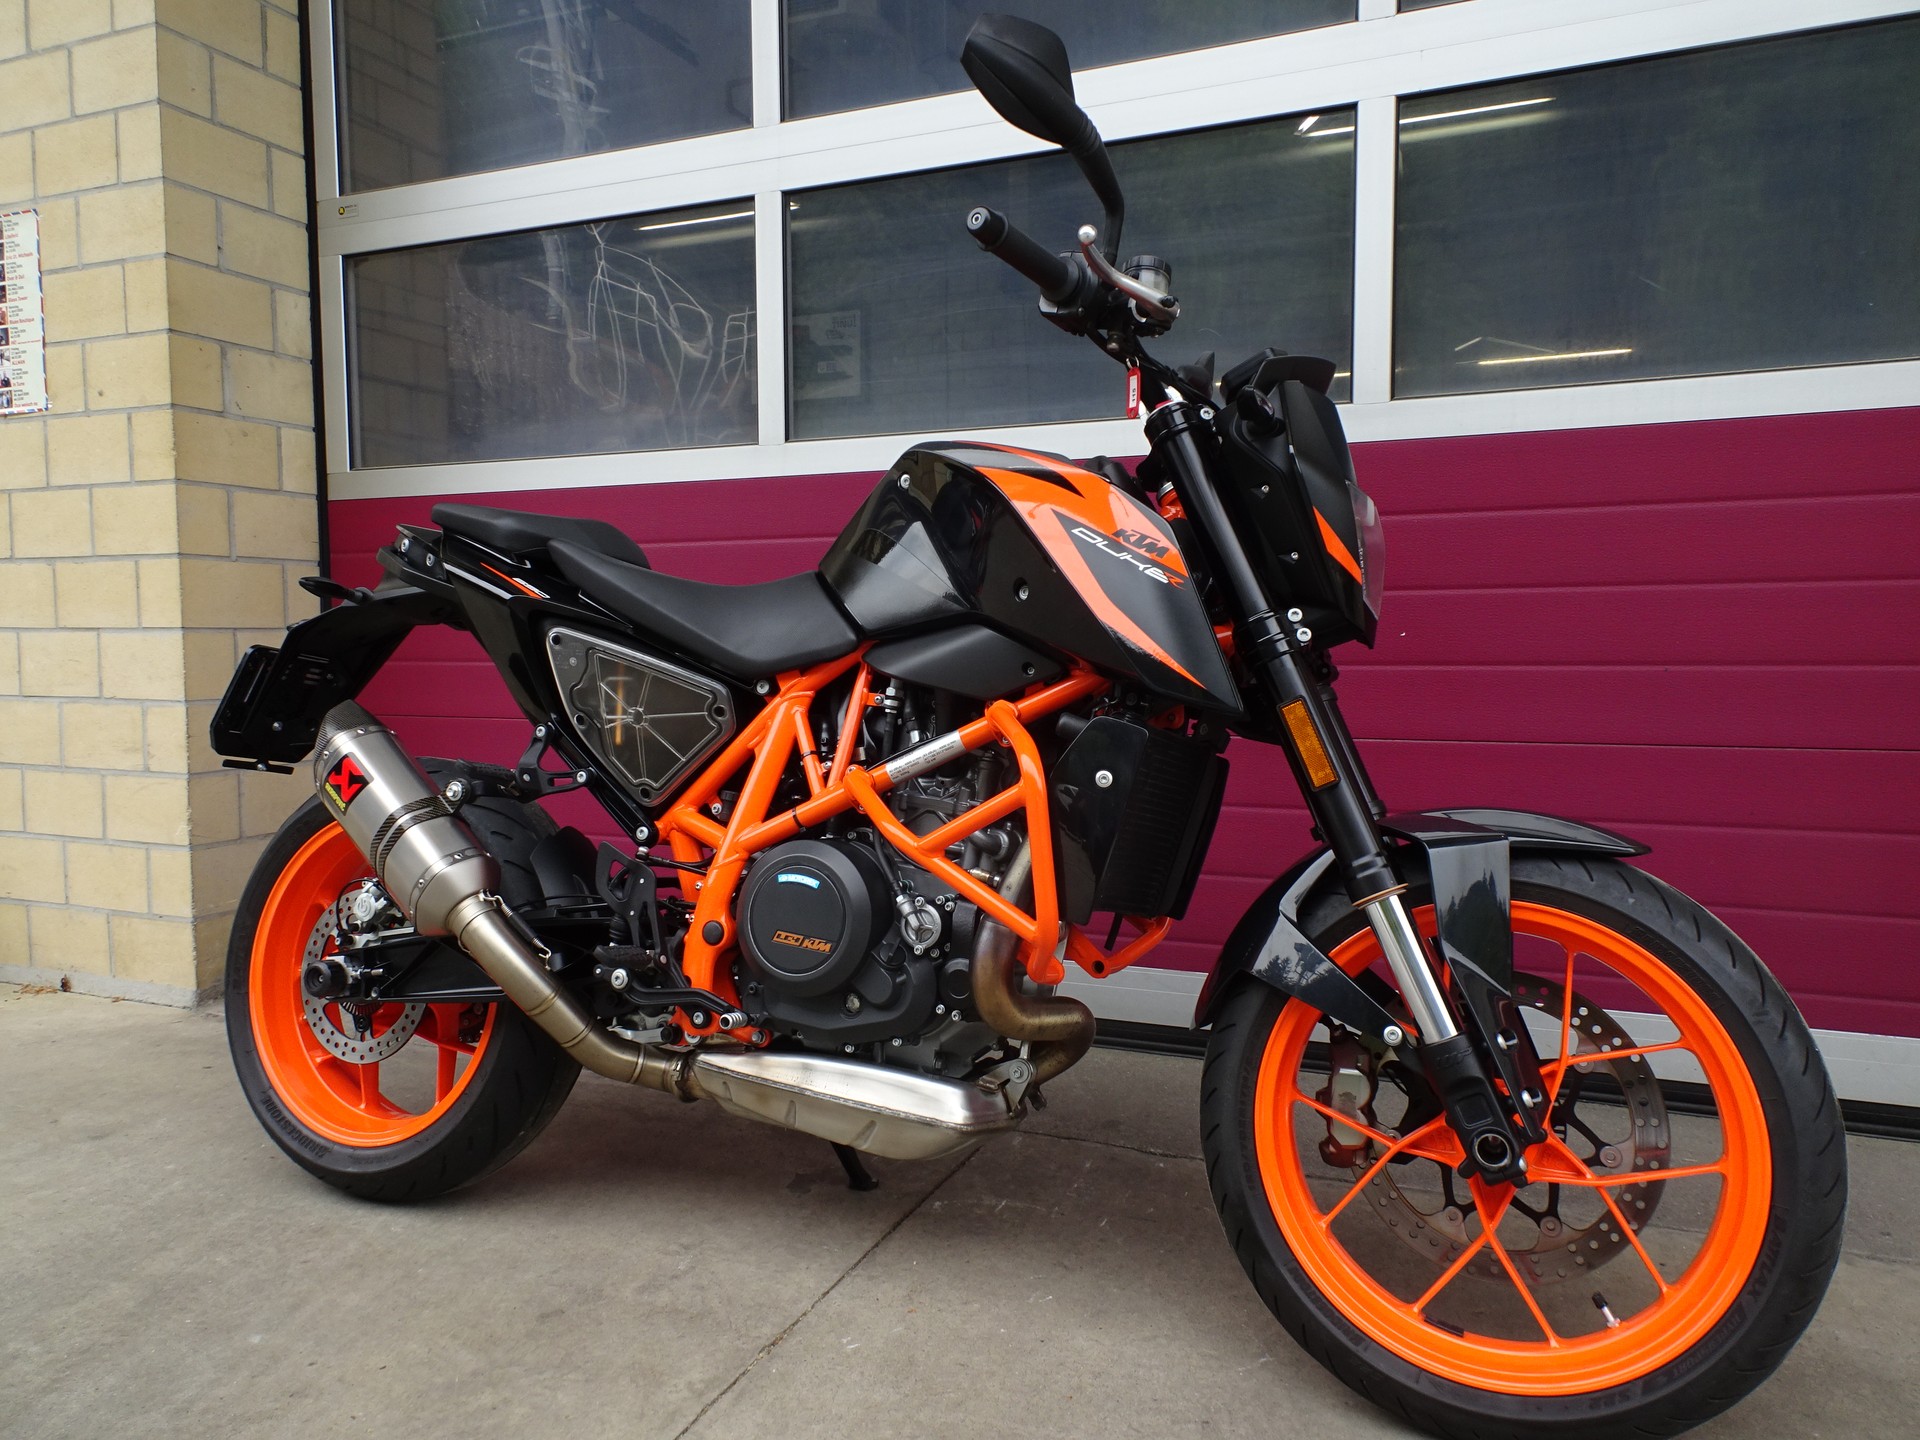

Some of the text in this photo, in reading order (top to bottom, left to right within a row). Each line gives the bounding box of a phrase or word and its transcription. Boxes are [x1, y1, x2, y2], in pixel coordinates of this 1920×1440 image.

[1071, 527, 1169, 584] DUKE
[1111, 528, 1170, 559] KTM
[802, 937, 833, 954] KTM
[260, 1094, 332, 1158] BRIDGESTONE
